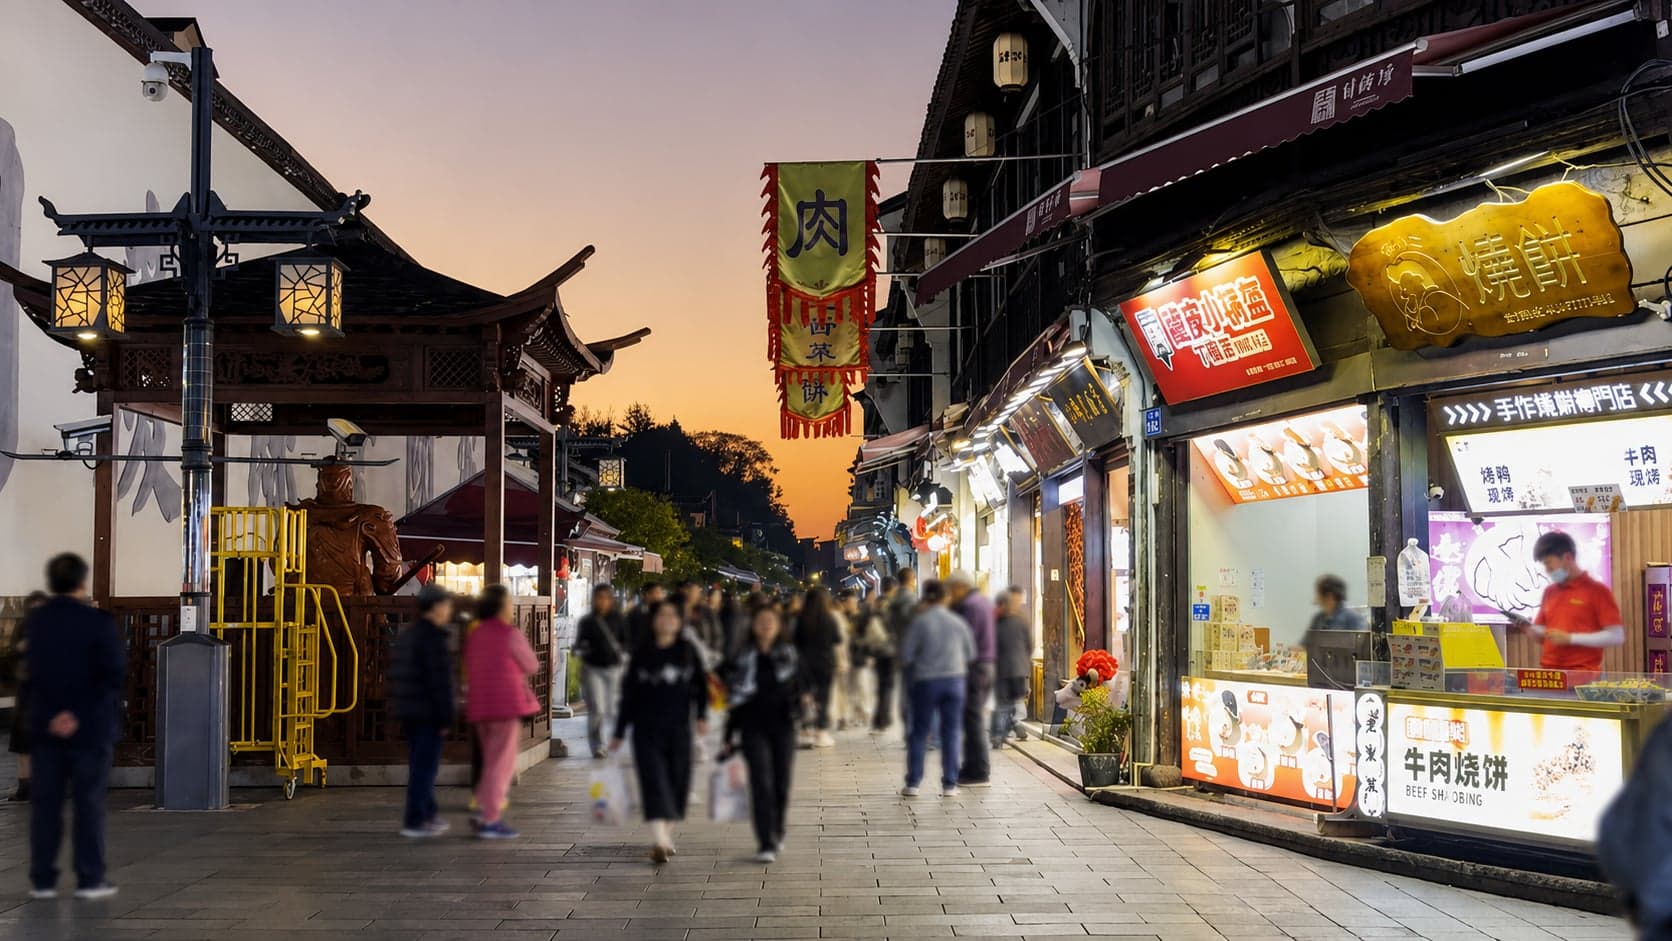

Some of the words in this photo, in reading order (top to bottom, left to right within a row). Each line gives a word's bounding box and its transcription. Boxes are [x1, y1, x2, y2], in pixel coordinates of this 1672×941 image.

[786, 189, 848, 259] 肉
[1458, 216, 1588, 304] 燒餅
[1624, 445, 1657, 466] 牛肉
[1480, 465, 1511, 485] 烤鸭
[1629, 468, 1660, 487] 现烤
[1404, 746, 1508, 792] 牛肉烧饼
[1406, 785, 1428, 799] BEEF
